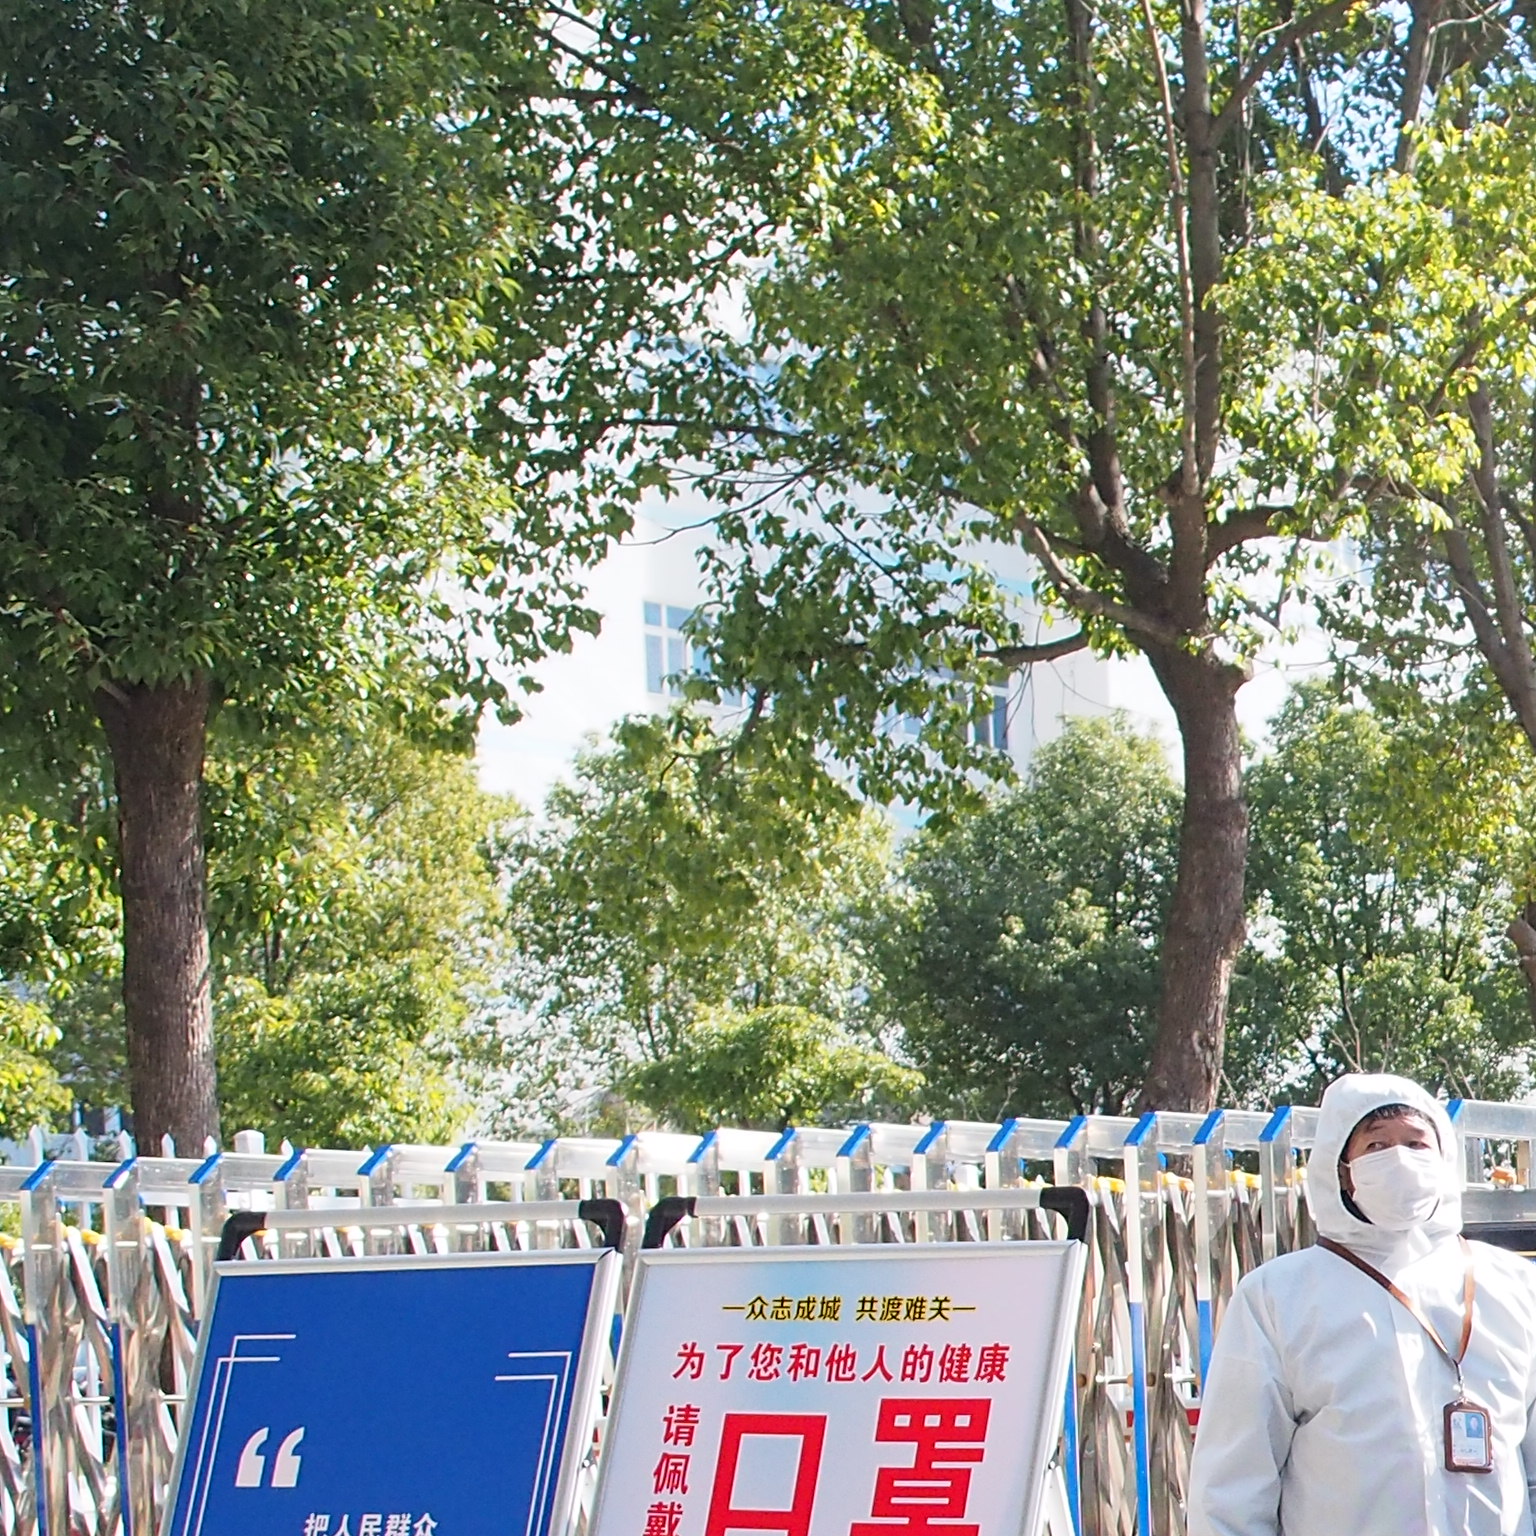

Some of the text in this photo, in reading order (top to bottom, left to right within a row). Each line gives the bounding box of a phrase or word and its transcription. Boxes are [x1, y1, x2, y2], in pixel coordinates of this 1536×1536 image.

[744, 1295, 952, 1323] 众志成城 共渡难关
[672, 1342, 1010, 1384] 为了您和他人的健康
